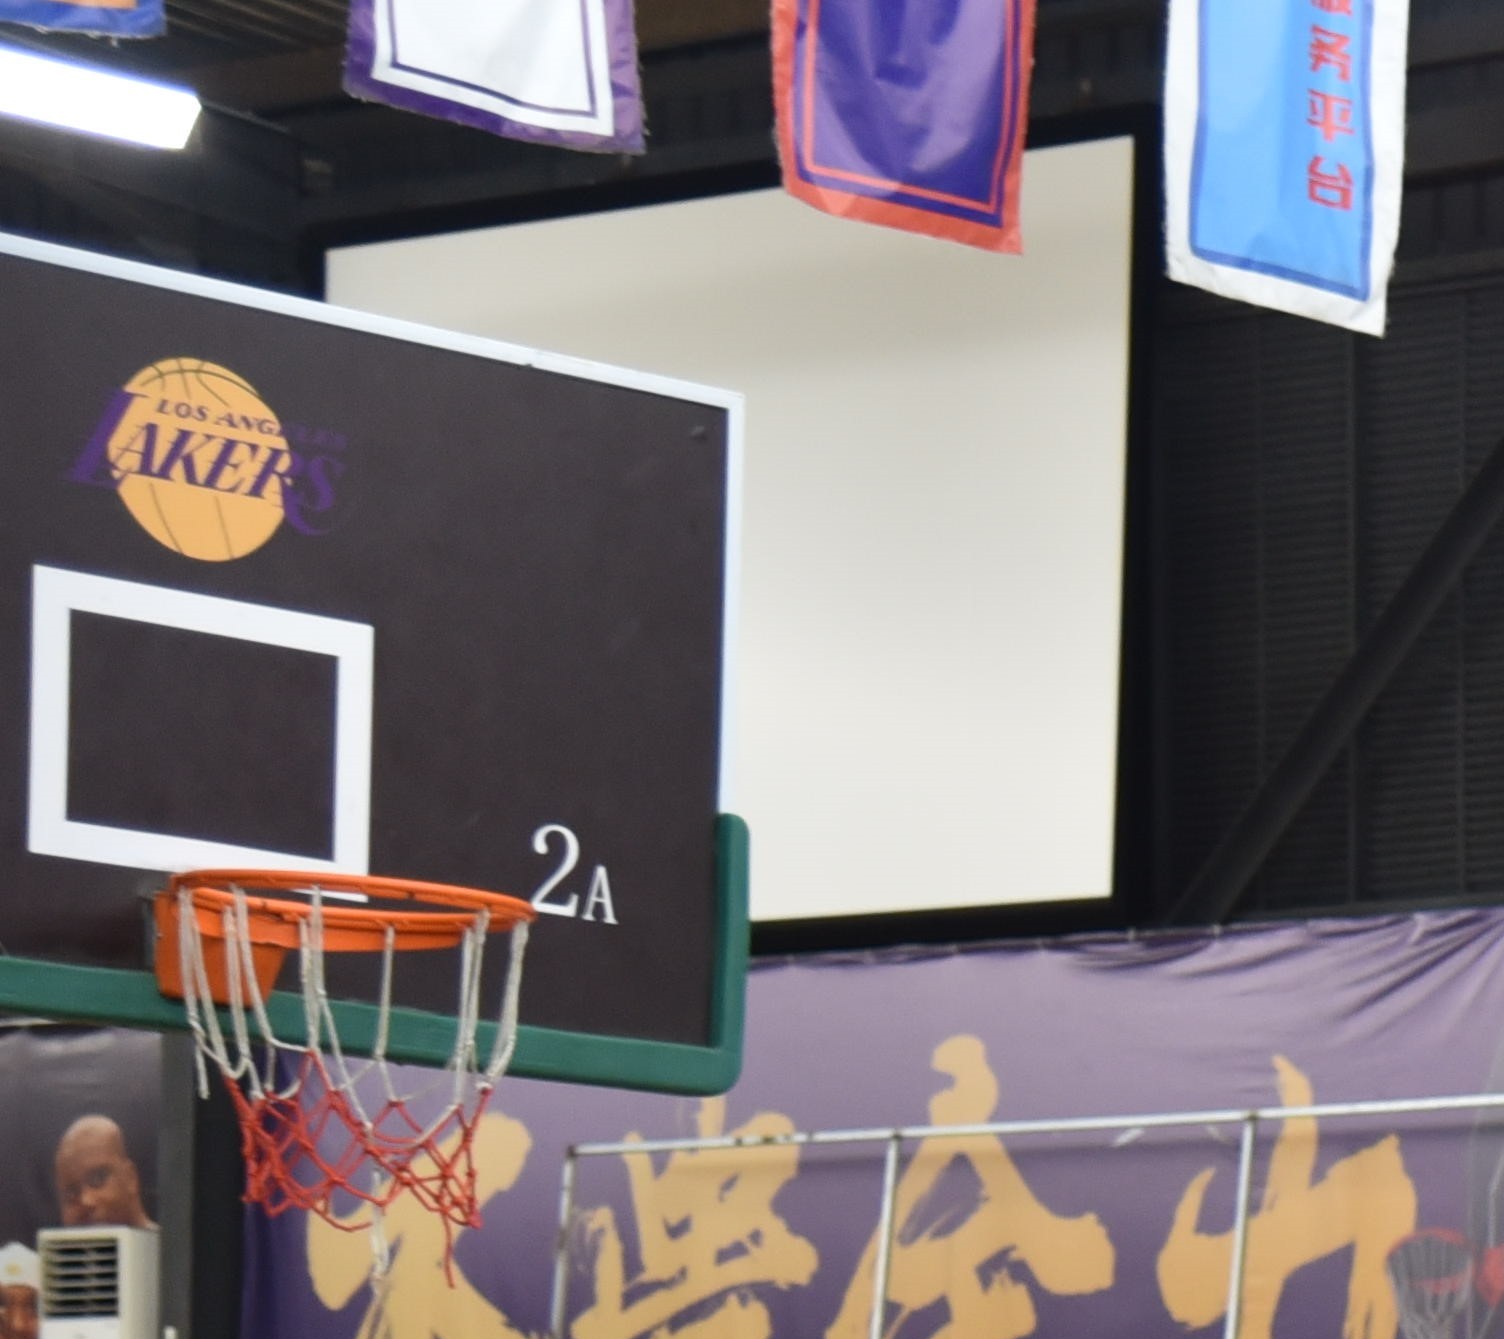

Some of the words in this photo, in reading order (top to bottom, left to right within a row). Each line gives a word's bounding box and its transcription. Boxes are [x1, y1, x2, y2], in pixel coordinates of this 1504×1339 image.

[1307, 0, 1355, 212] 务平台
[66, 387, 347, 537] LAKERS
[156, 399, 209, 421] LOS
